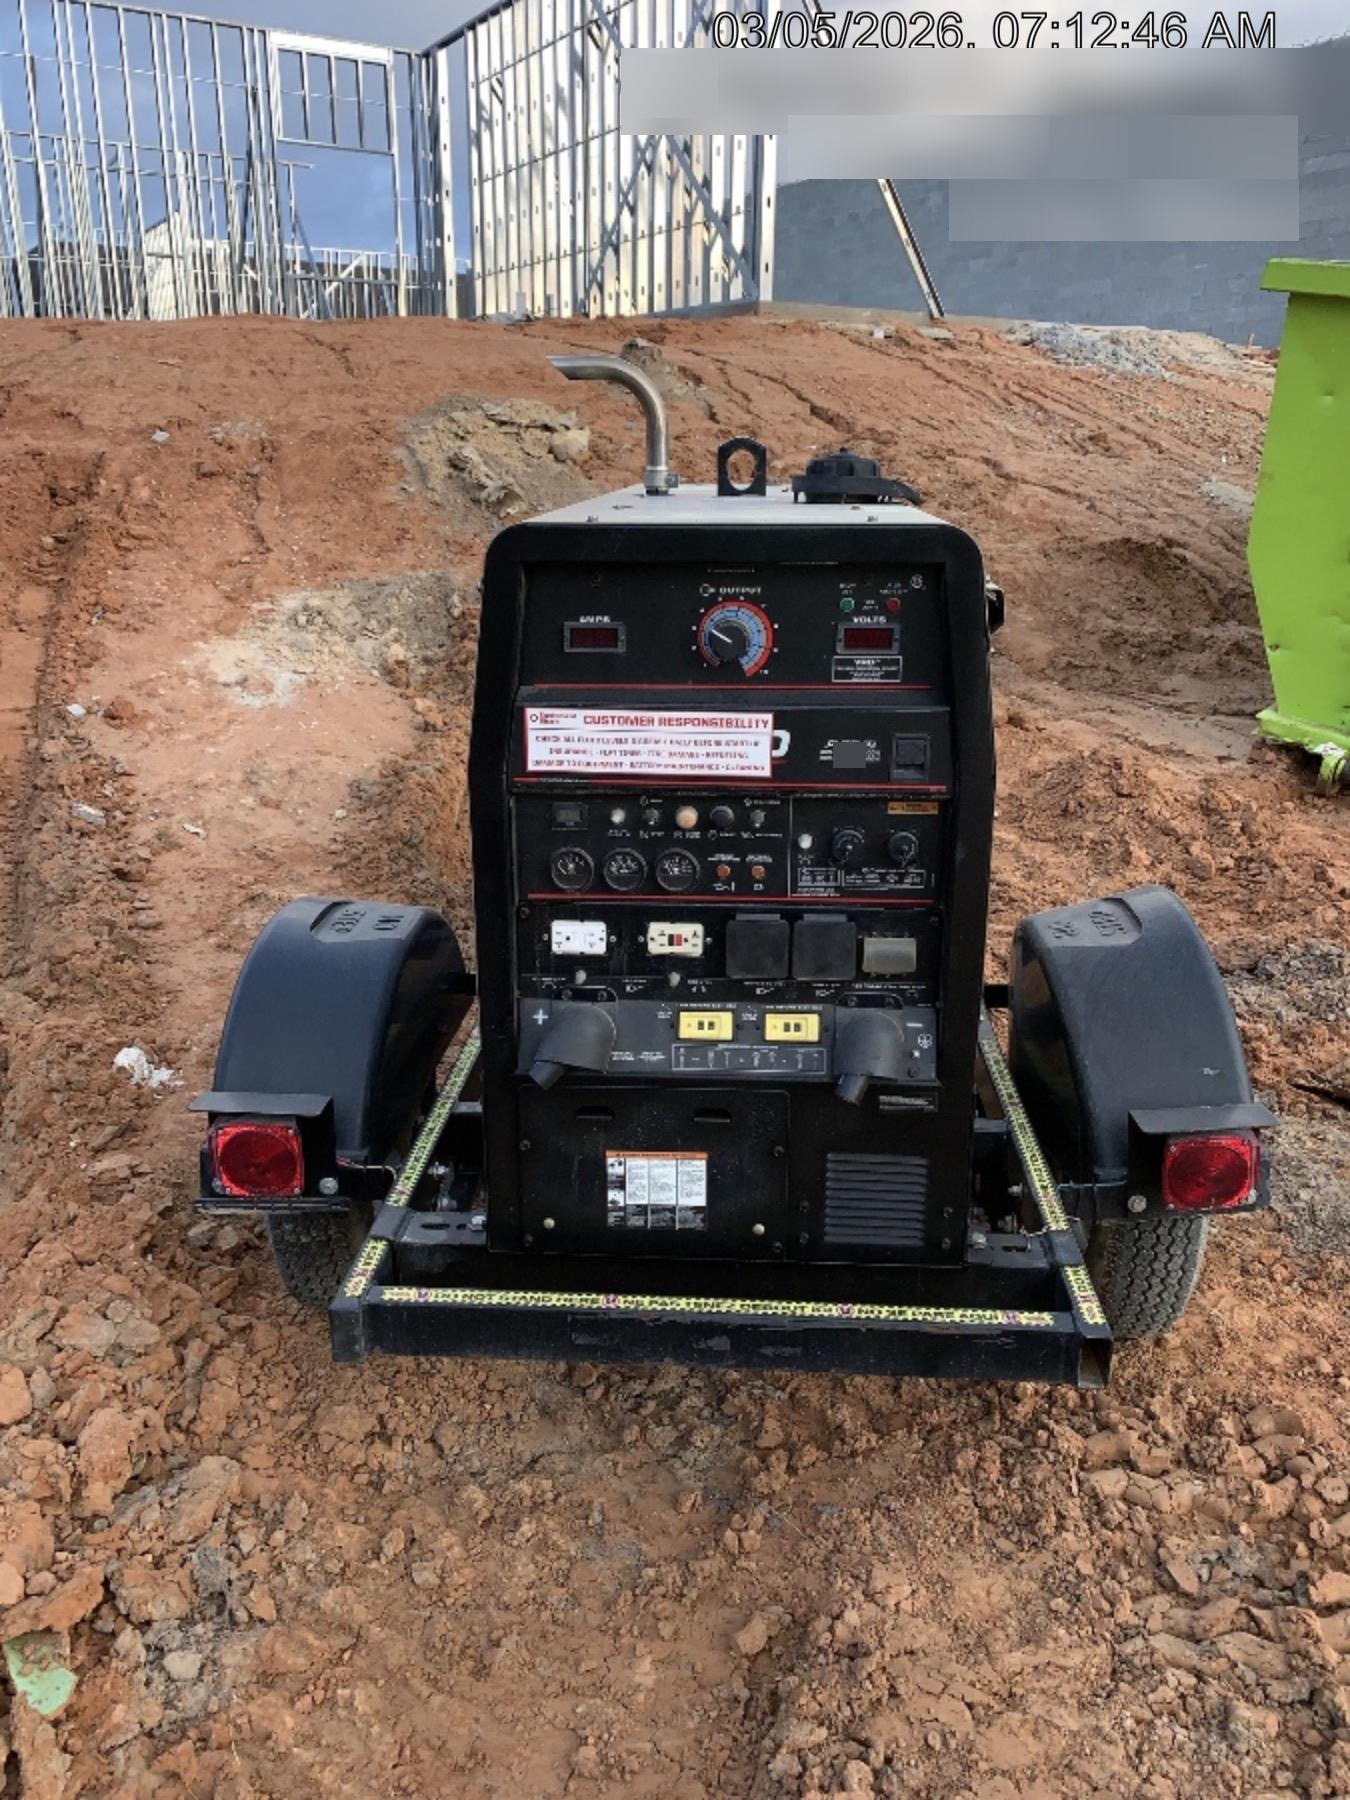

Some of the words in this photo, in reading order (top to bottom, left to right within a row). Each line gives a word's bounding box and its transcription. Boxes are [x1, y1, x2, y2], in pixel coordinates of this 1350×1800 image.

[718, 586, 763, 595] OUTPUT
[853, 616, 887, 624] VOLTS
[583, 715, 656, 727] CUSTOMER
[658, 717, 769, 729] RESPONSIBILITY
